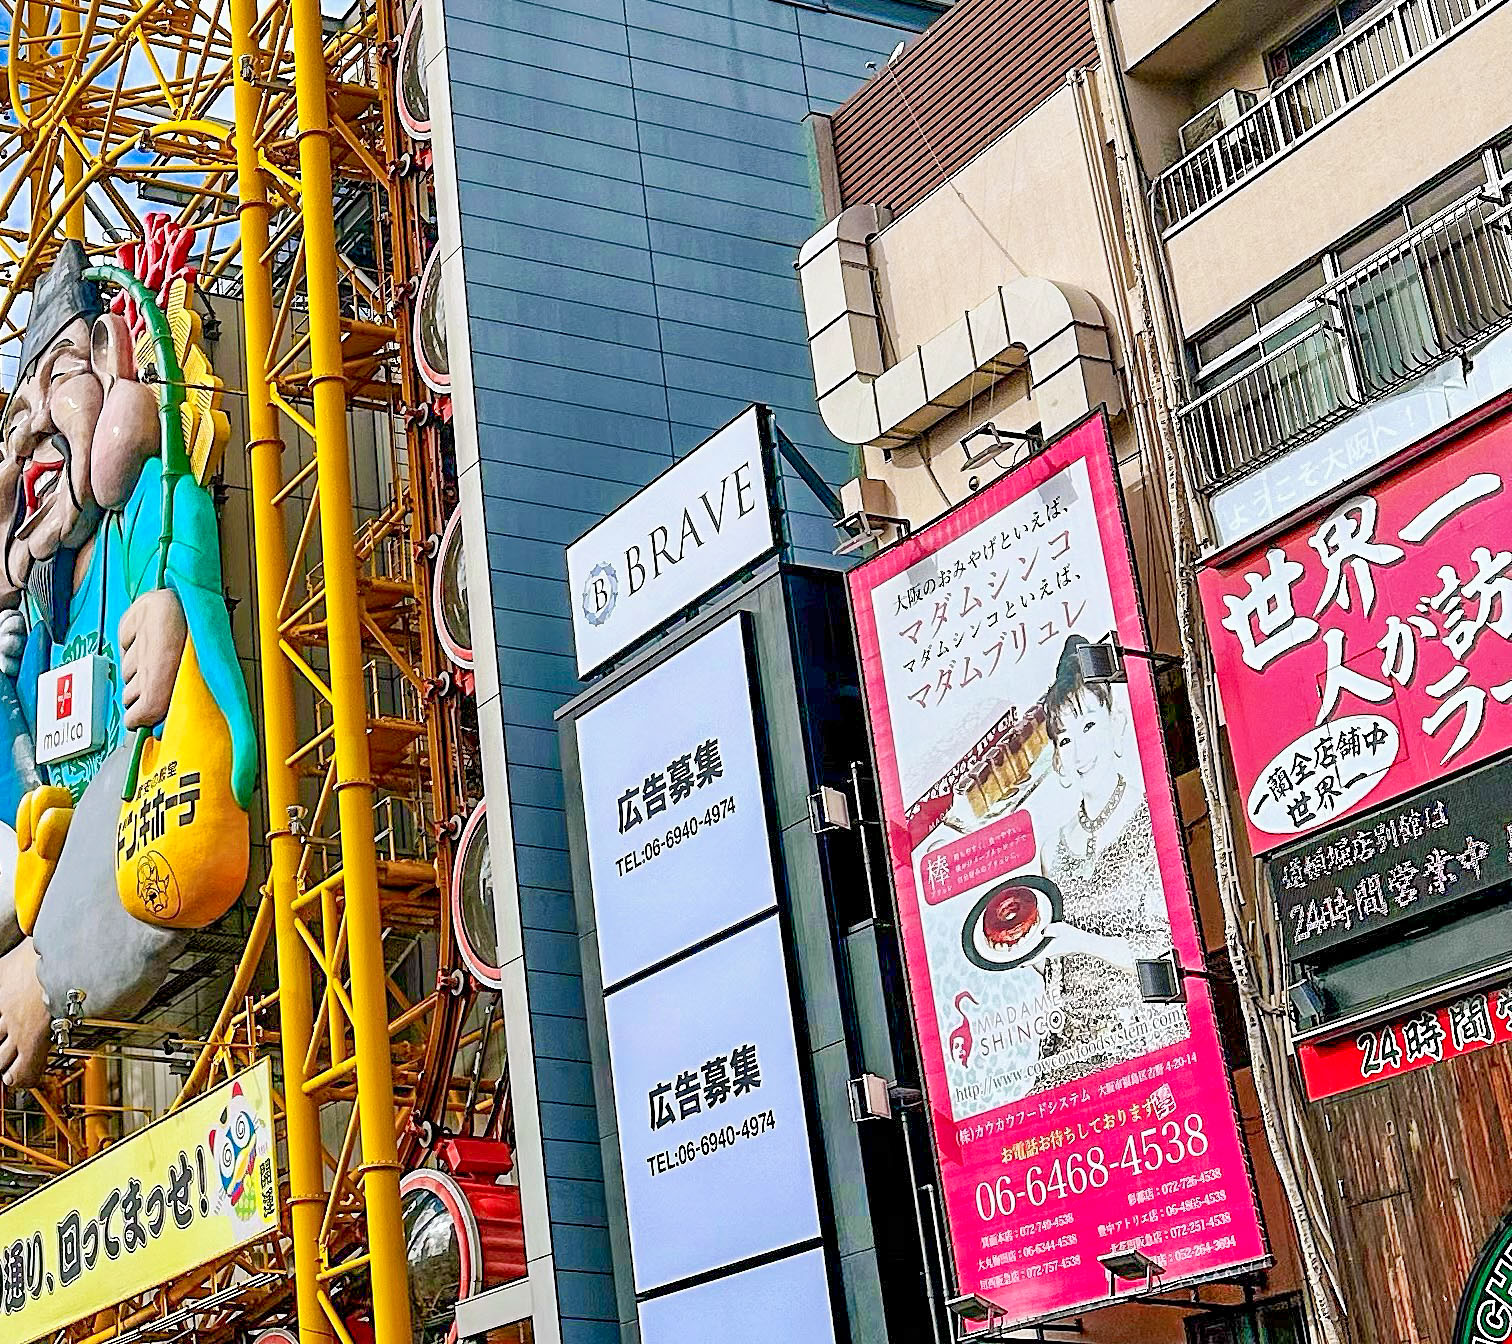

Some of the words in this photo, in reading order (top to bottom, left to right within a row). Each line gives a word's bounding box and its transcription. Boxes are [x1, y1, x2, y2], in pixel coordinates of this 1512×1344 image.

[624, 462, 758, 595] BRAVE
[892, 495, 1069, 617] 大阪のおみやげといえば、
[1222, 472, 1504, 672] 世界一
[898, 528, 1072, 646] マダムシンコ
[902, 565, 1082, 674] マダムシンコといえば、
[906, 599, 1088, 710] マダムブリュレ
[615, 737, 725, 836] 広告募集
[1252, 721, 1390, 816] 一蘭全店舗中
[1286, 771, 1368, 828] 世界一
[615, 796, 737, 877] TEL:06-6940-4974
[926, 855, 950, 887] 棒
[977, 989, 1063, 1034] MADAME
[648, 1043, 763, 1132] 広告募集
[647, 1109, 777, 1177] TEL:06-6940-4974
[975, 1113, 1210, 1222] 06-6468-4538
